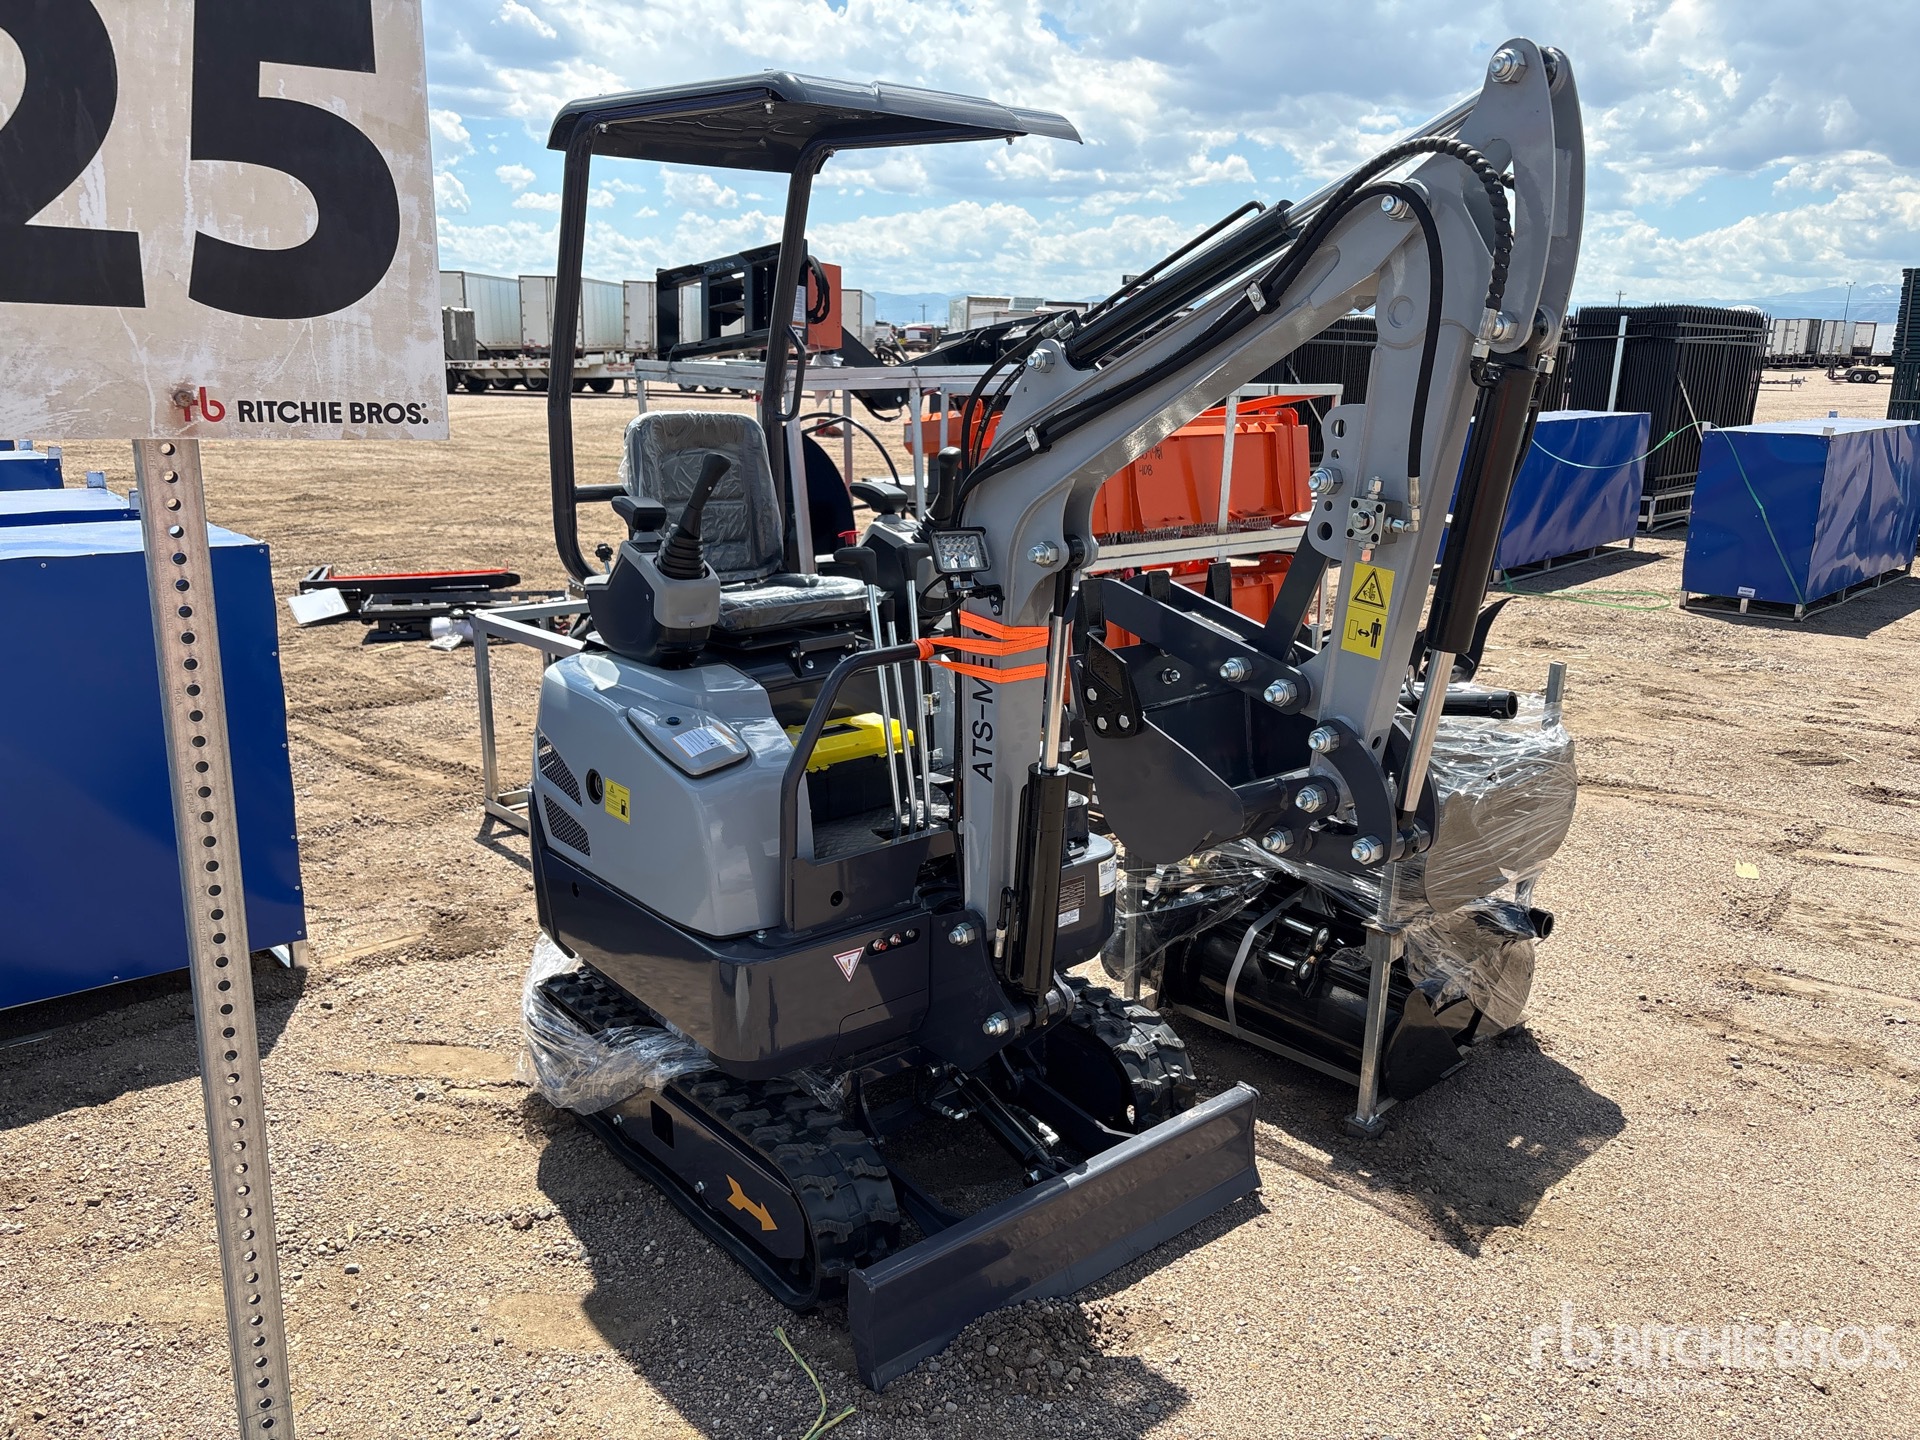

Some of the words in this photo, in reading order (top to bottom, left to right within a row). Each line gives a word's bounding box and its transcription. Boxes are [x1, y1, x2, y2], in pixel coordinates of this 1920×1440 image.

[0, 0, 400, 319] 25
[237, 400, 343, 424] RITCHIE
[184, 779, 196, 814] TELESPAR
